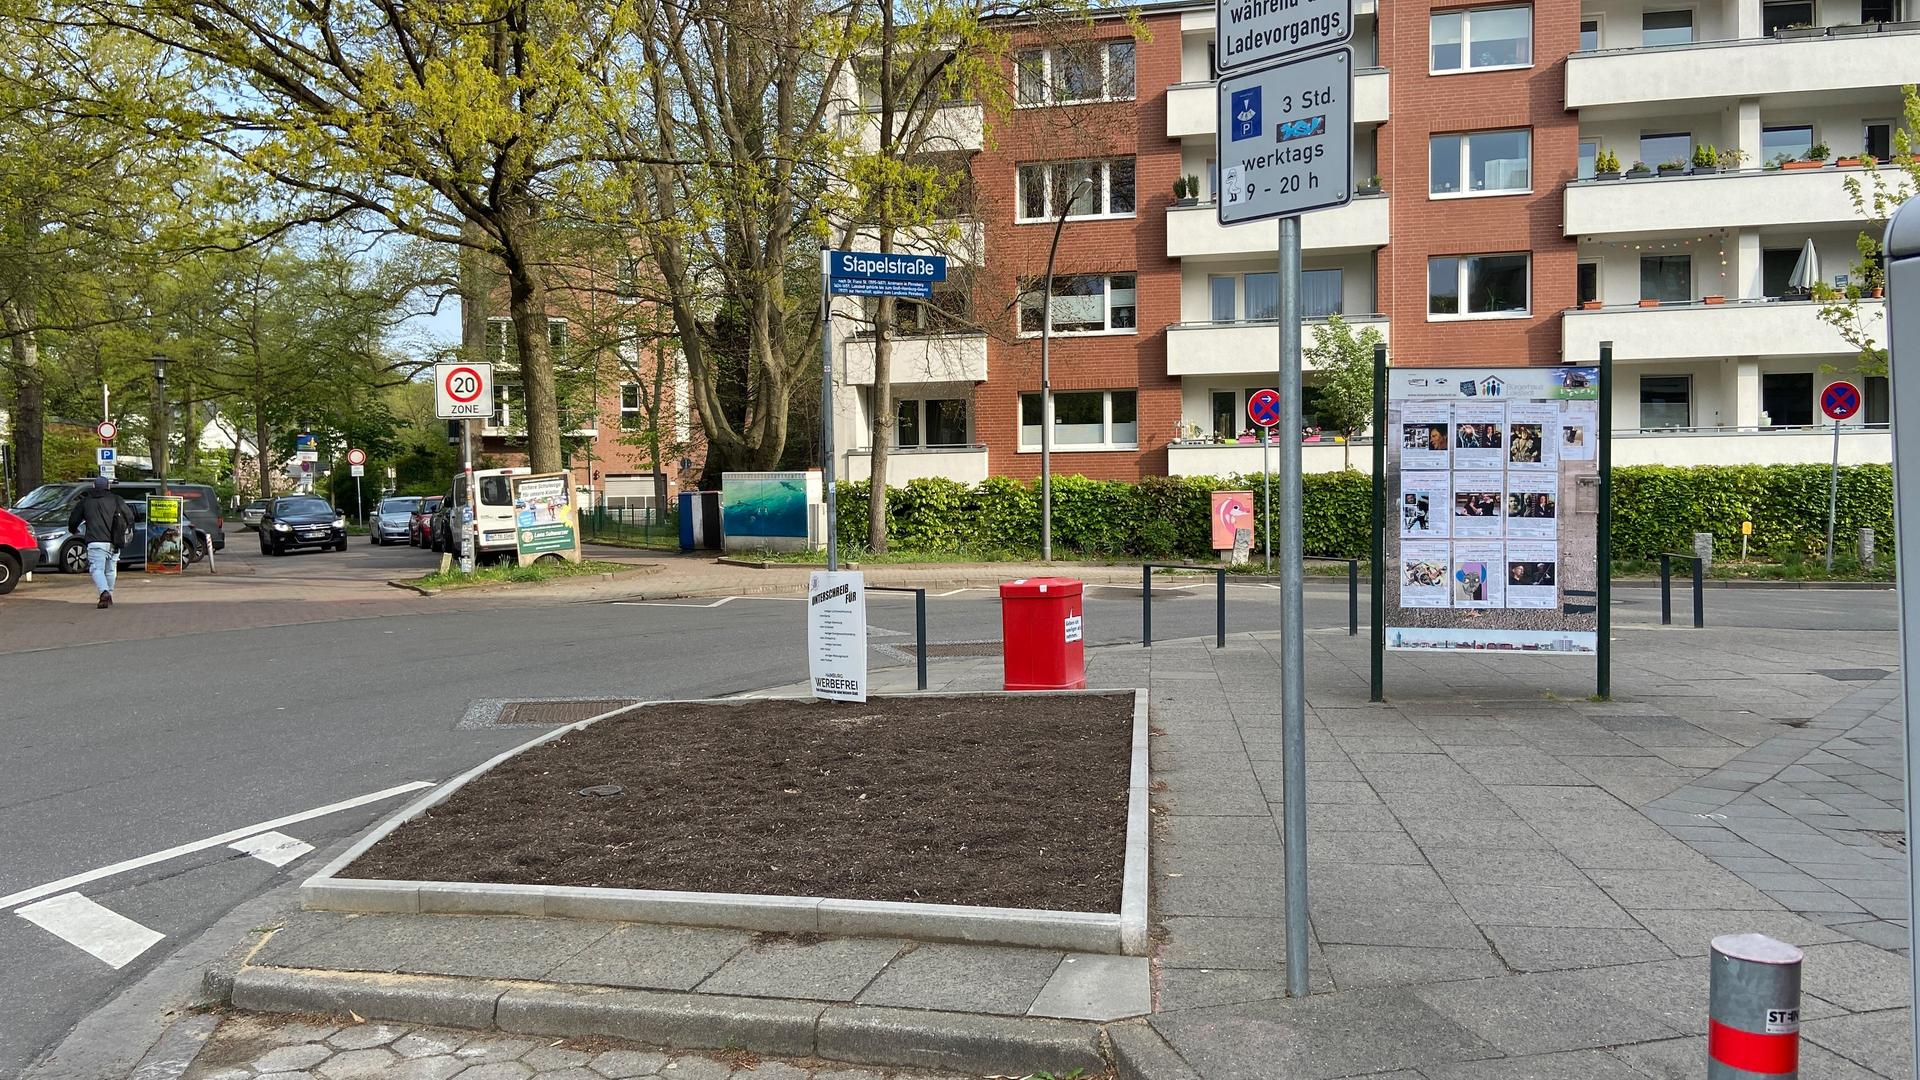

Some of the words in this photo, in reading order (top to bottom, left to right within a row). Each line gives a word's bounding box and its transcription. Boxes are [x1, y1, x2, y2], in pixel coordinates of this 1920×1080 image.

[1227, 12, 1340, 56] Ladevorgangs
[1282, 96, 1292, 113] 3
[1302, 86, 1336, 109] Std.
[1242, 143, 1324, 172] werktags
[1247, 183, 1255, 201] 9
[1280, 174, 1300, 195] 20
[1309, 172, 1319, 188] h
[843, 255, 934, 277] Stapelstraße
[454, 377, 475, 393] 20
[451, 405, 479, 414] ZONE
[812, 583, 849, 606] UNTERSCHREIB
[845, 591, 857, 604] FÜR
[815, 677, 858, 690] WERBEFREI
